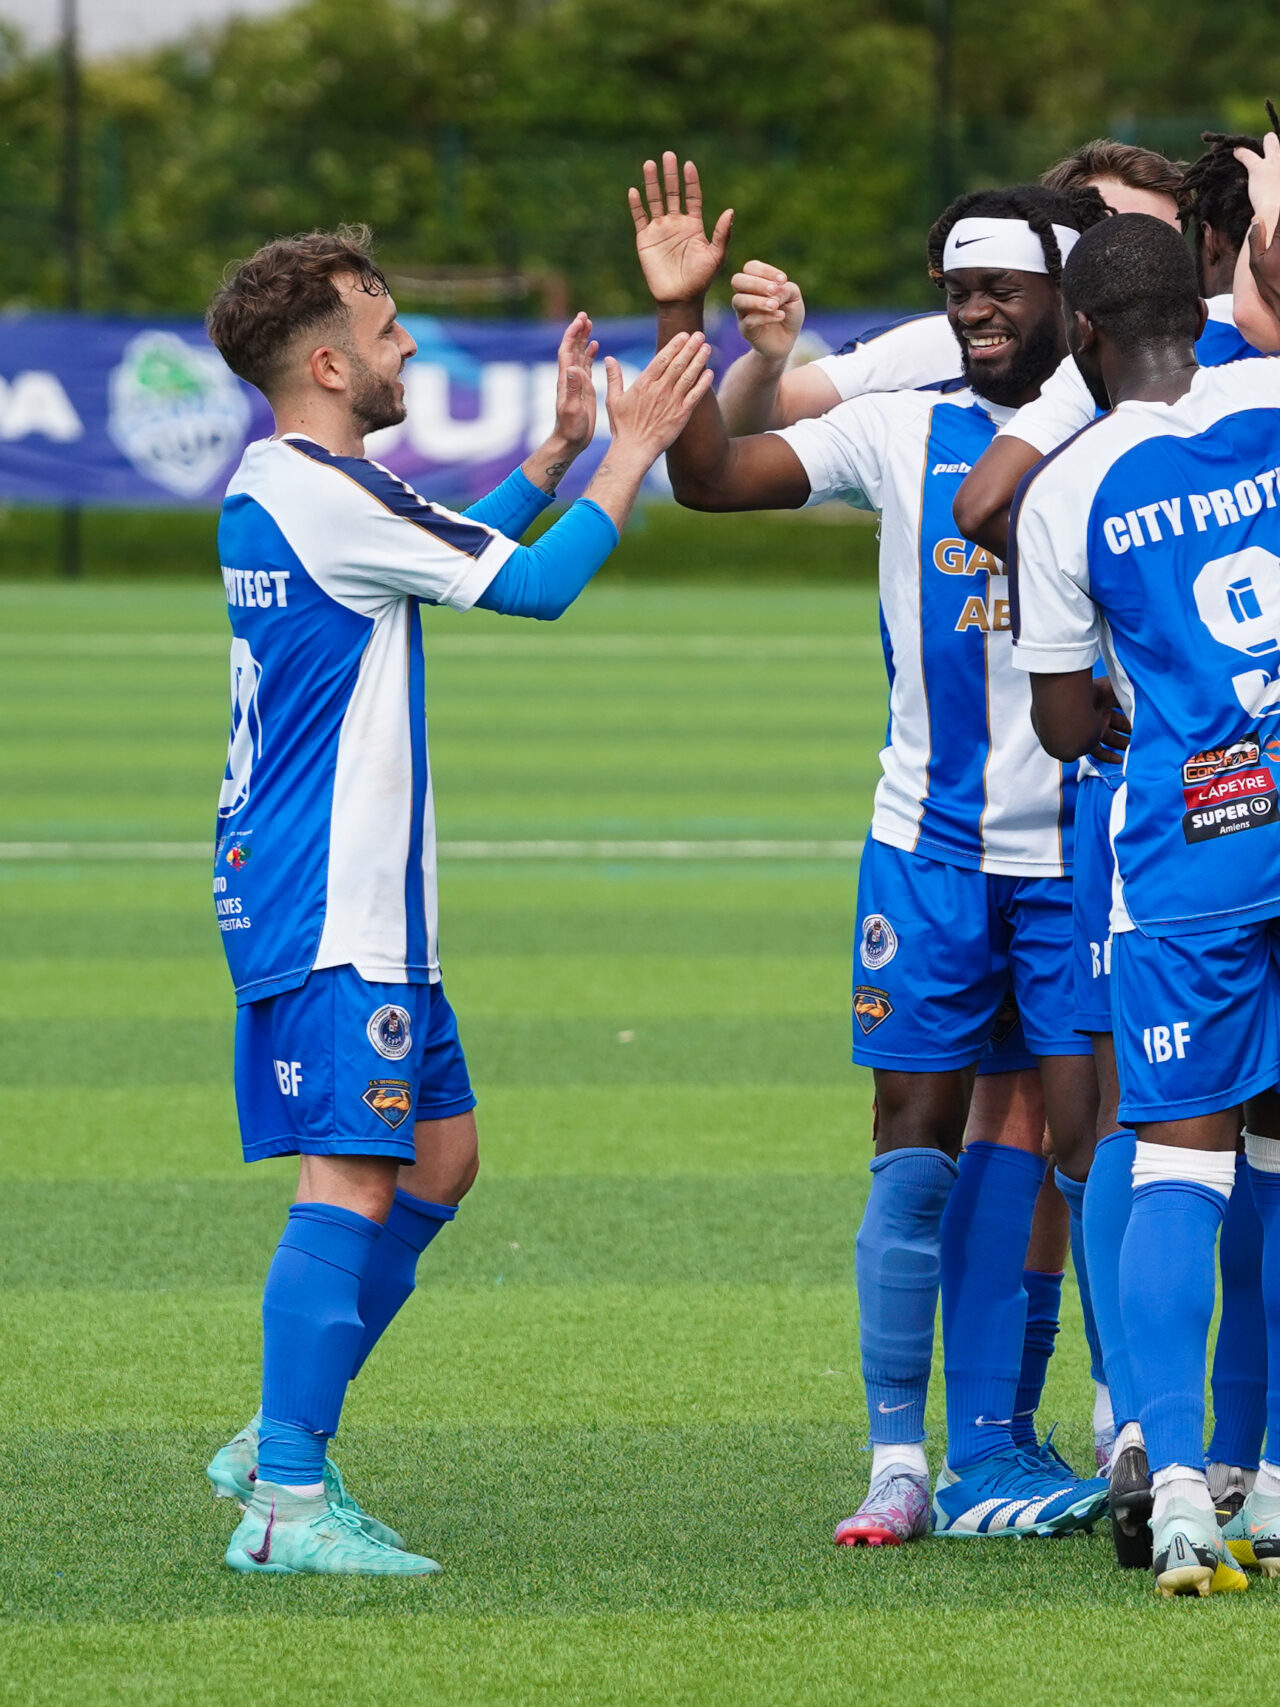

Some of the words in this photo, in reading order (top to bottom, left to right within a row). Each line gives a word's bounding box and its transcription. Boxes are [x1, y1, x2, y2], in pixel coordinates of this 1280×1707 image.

[0, 369, 83, 441] A
[1103, 496, 1184, 555] CITY
[1192, 803, 1250, 829] SUPER
[1199, 820, 1250, 835] Amiens
[1143, 1021, 1191, 1064] IBF
